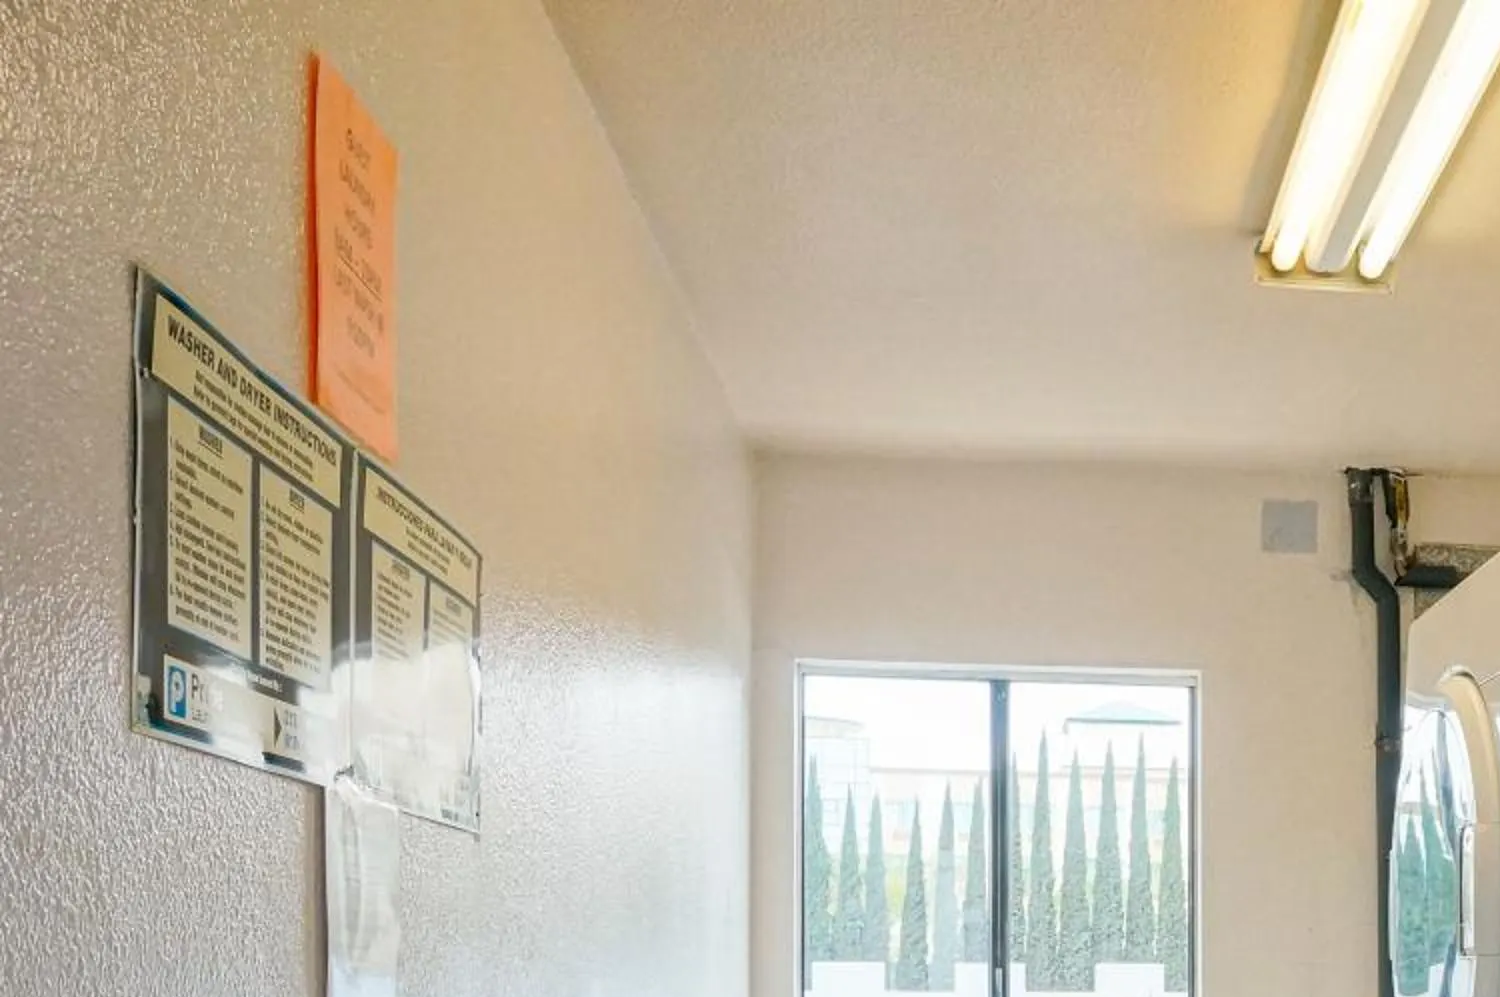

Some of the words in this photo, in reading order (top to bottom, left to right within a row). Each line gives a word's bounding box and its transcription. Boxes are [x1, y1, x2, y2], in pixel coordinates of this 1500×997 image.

[168, 314, 214, 370] WASHER
[217, 357, 237, 388] AND
[240, 377, 272, 416] DRYER
[274, 403, 337, 467] INSTRUCTIONS
